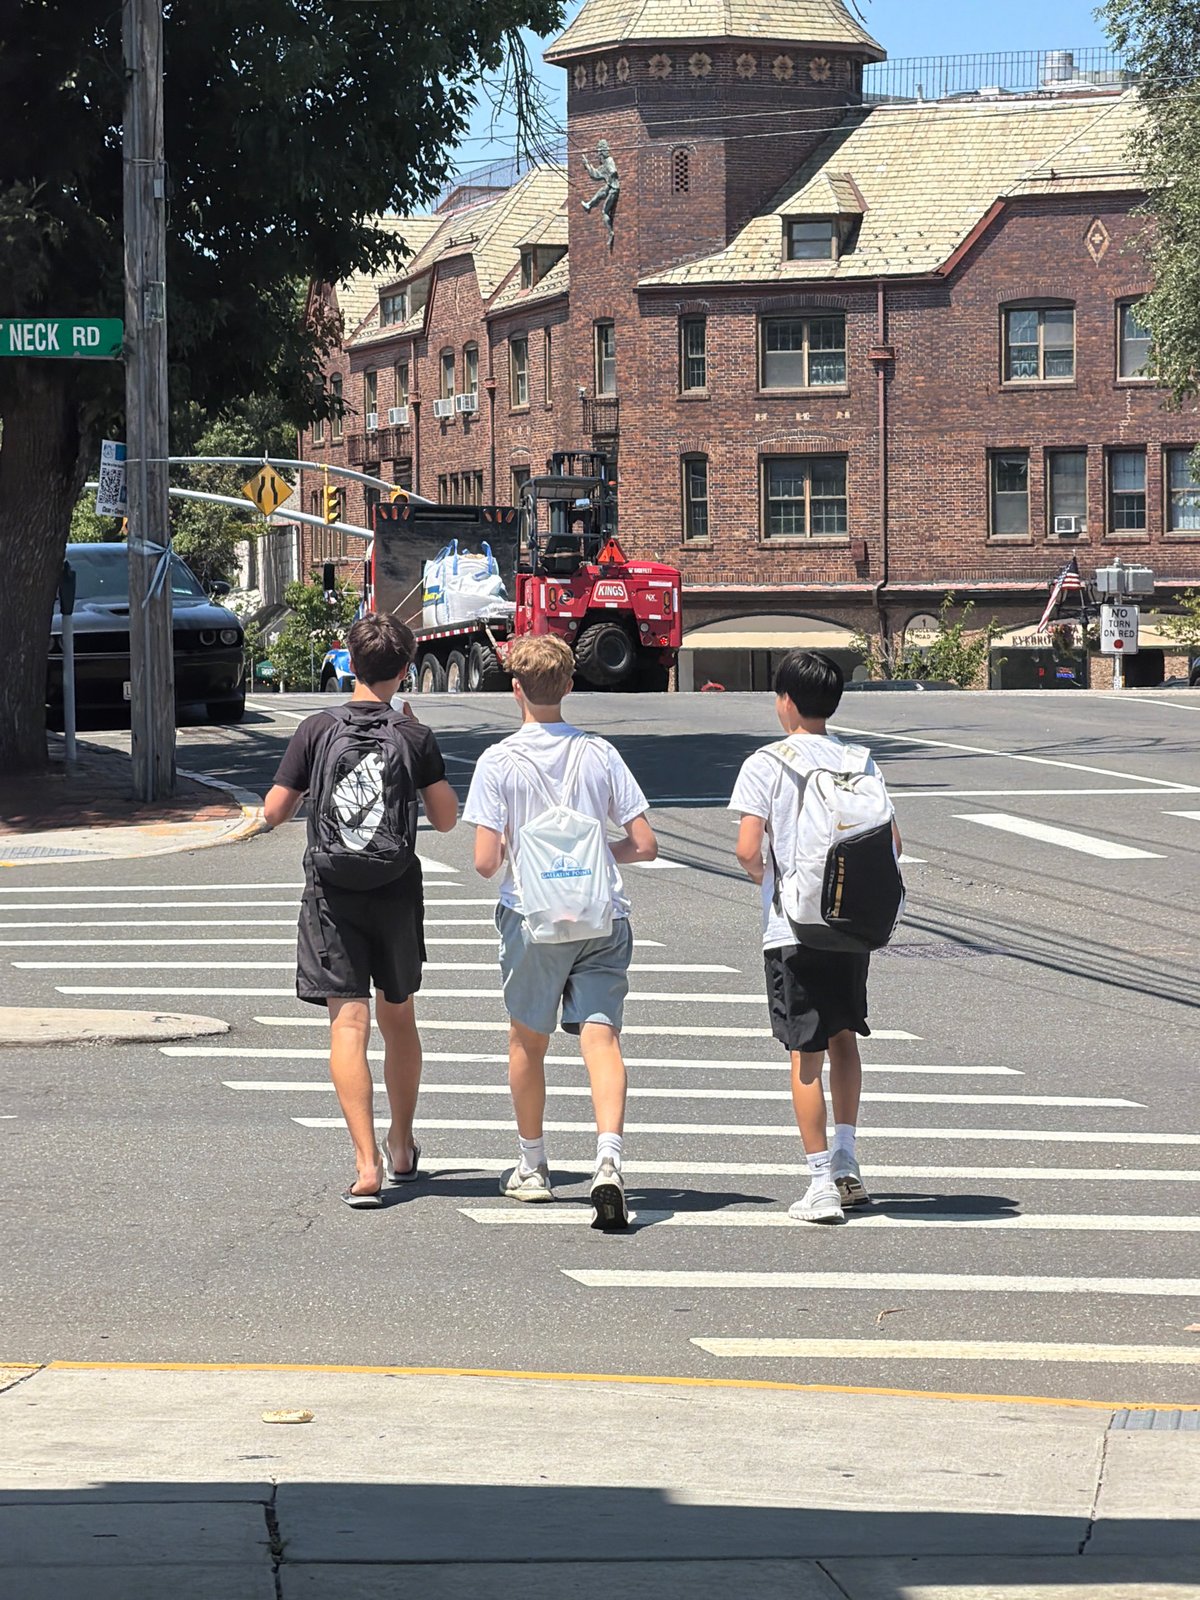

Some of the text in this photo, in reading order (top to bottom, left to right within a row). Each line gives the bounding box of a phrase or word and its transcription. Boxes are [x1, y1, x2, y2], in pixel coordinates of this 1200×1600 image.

[9, 323, 100, 351] NECK RD
[598, 585, 624, 597] KINGS
[1111, 608, 1128, 618] NO
[1109, 620, 1130, 628] TURN
[1103, 629, 1135, 638] ON RED
[1012, 635, 1052, 645] EYEBRO
